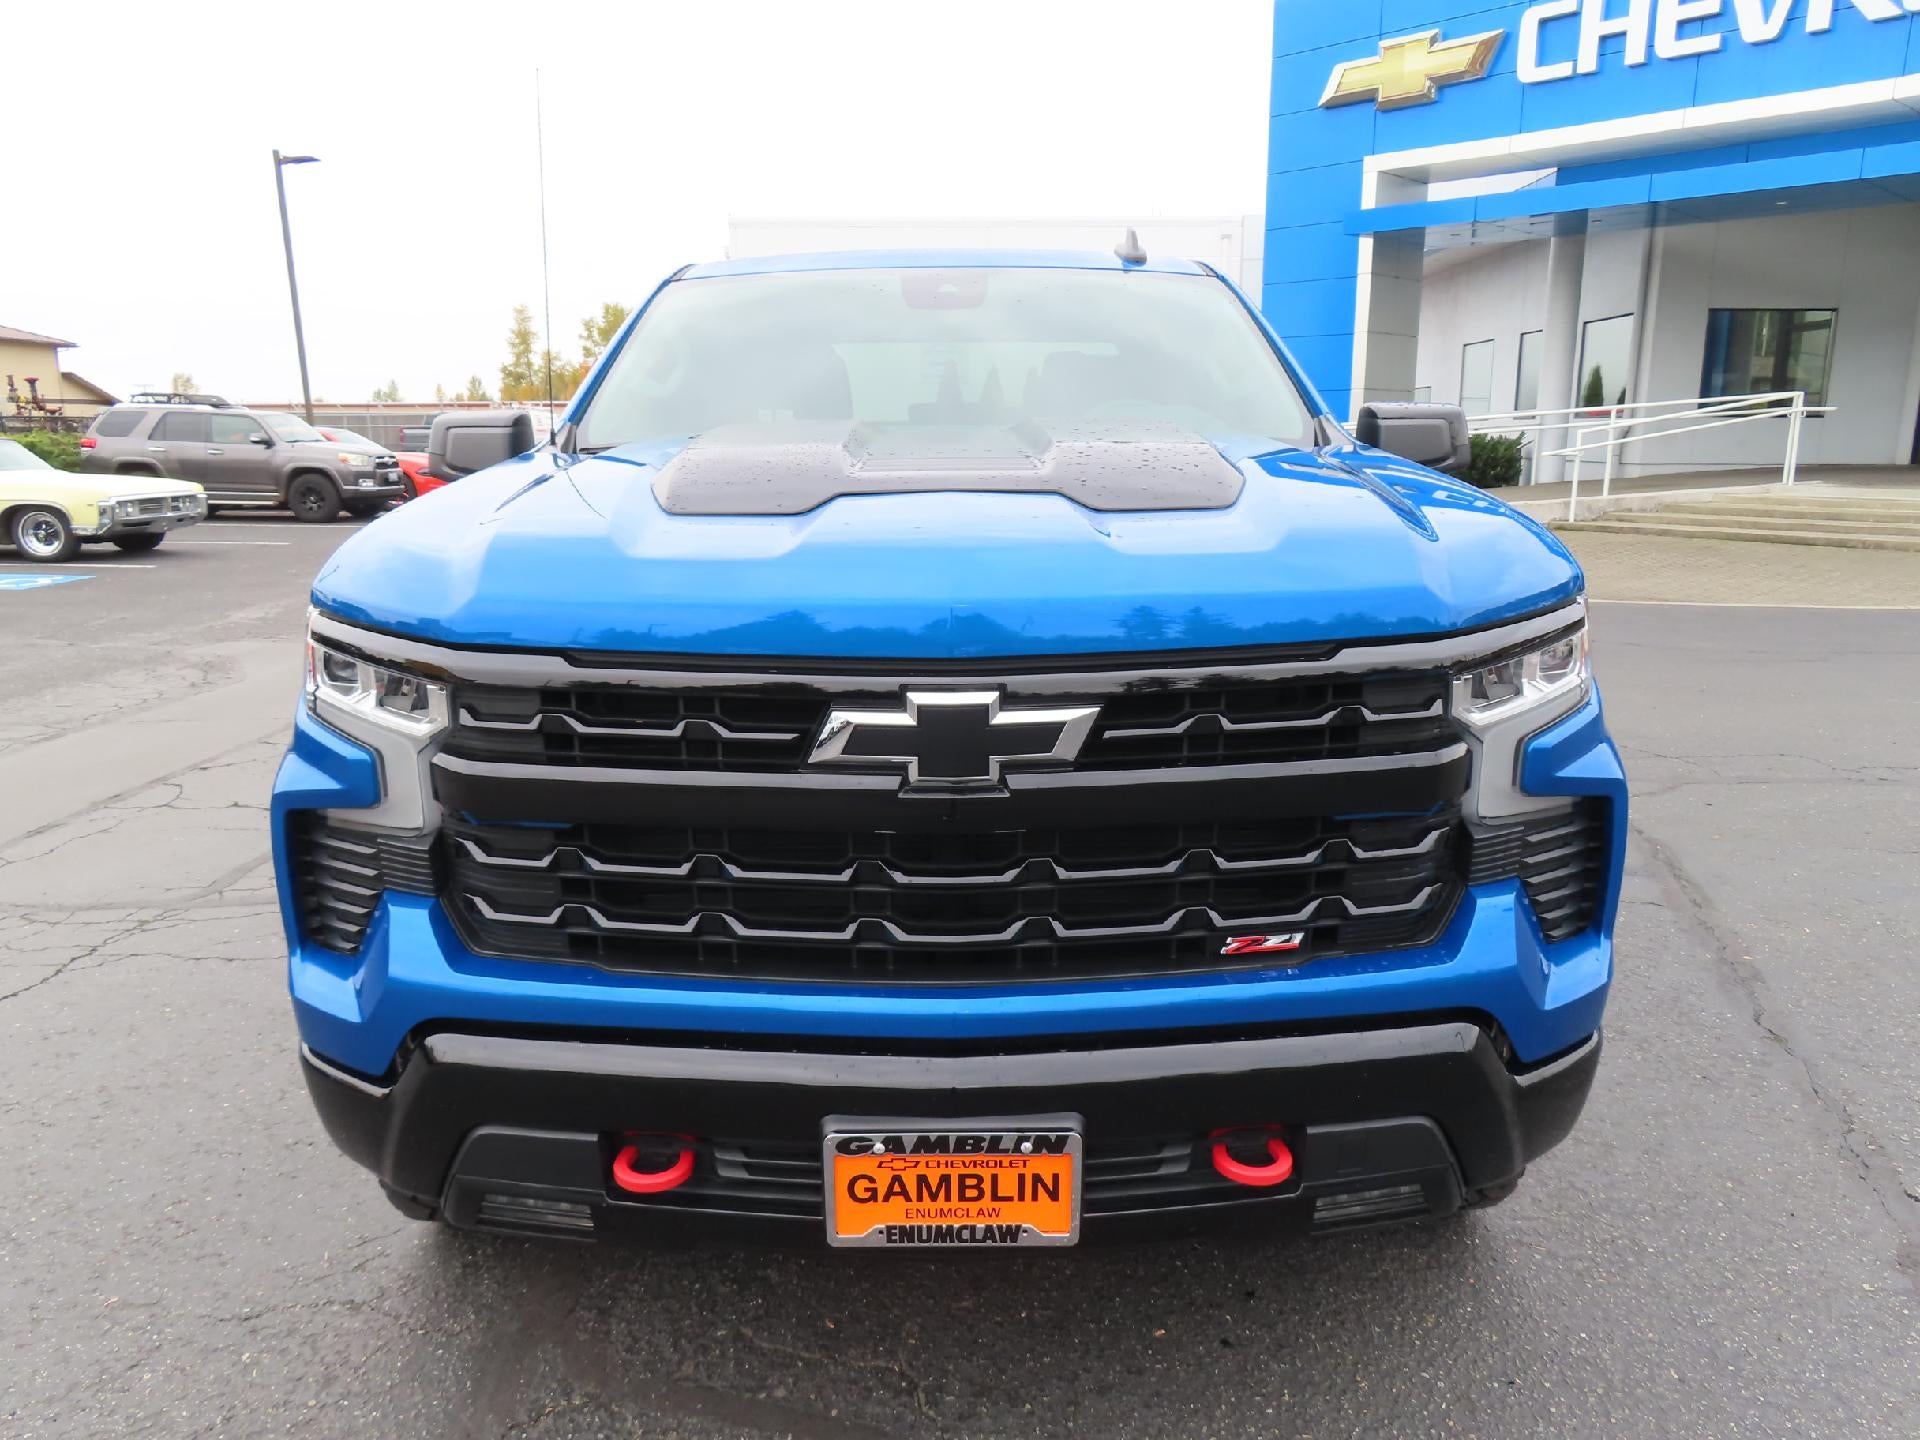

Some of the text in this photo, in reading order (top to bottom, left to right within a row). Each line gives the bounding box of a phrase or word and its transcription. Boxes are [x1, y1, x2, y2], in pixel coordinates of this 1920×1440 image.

[1516, 0, 1920, 84] CHEV
[835, 1135, 1070, 1155] GAMBLIN
[925, 1159, 1030, 1169] CHEVROLET
[847, 1173, 1060, 1203] GAMBLIN
[905, 1207, 1002, 1219] ENUMCLAW
[885, 1225, 1022, 1244] ENUMCLAW
